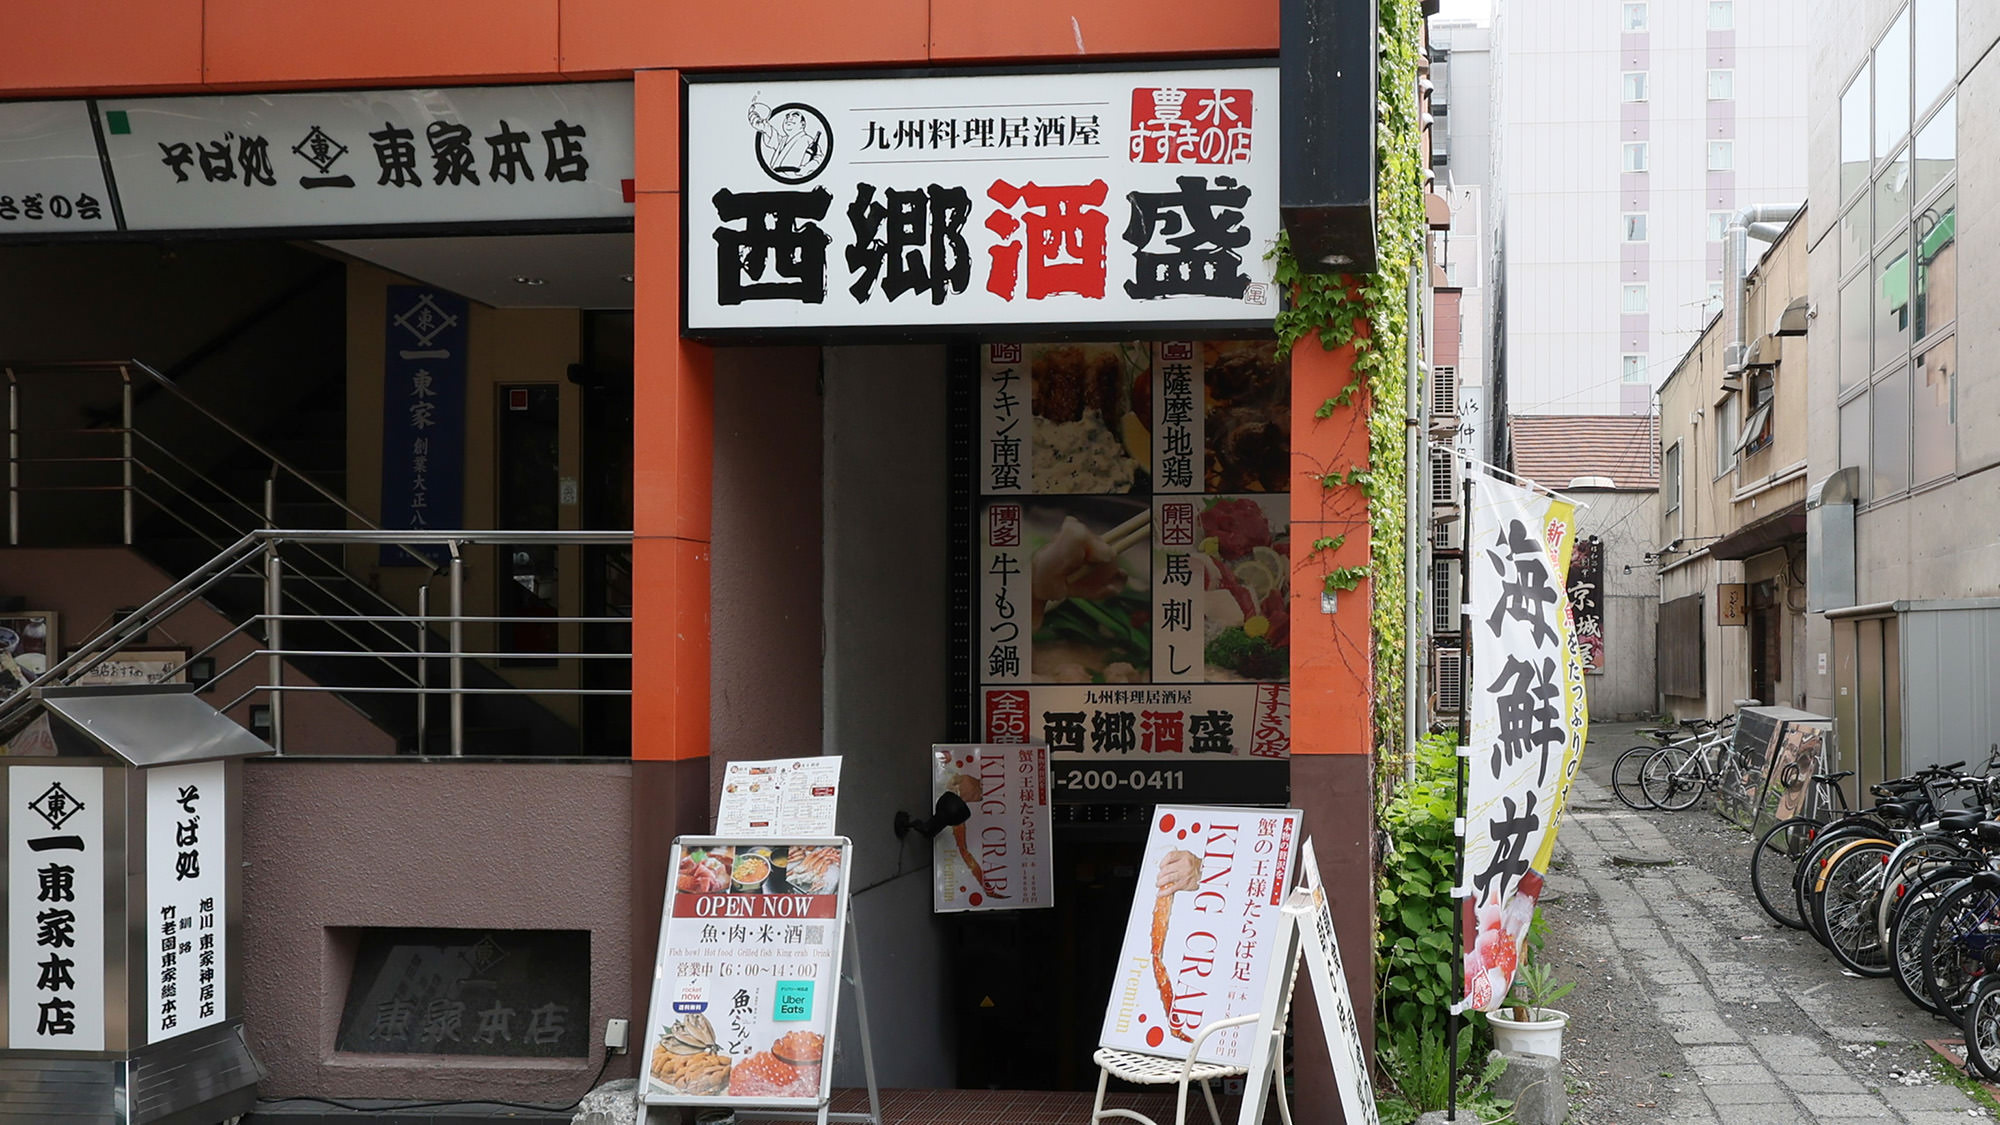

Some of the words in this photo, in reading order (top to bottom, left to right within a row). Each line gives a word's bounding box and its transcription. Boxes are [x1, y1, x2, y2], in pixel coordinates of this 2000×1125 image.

[859, 114, 1101, 152] 九州料理居酒屋
[1149, 87, 1239, 125] 豊水
[158, 132, 277, 187] そば処
[370, 119, 589, 188] 東家本店
[1129, 126, 1251, 166] すすきの店
[711, 174, 1252, 306] 西郷酒盛
[409, 368, 438, 430] 東家
[991, 369, 1022, 491] チキン南蛮
[1161, 364, 1193, 488] 薩摩地鶏
[409, 437, 429, 530] 創業大正八
[991, 506, 1019, 546] 博多
[1165, 505, 1192, 544] 熊本
[988, 553, 1021, 678] 牛もつ鍋
[1161, 553, 1193, 676] 馬刺し
[1043, 710, 1234, 753] 西郷酒盛
[1083, 690, 1192, 704] 九州料理居酒屋
[980, 756, 1007, 816] KING
[1018, 749, 1036, 856] 蟹の王様たらば足
[176, 785, 200, 882] そば処
[981, 826, 1009, 895] CRAB
[1194, 823, 1239, 915] KING
[1231, 817, 1278, 982] 蟹の王様たらば足
[697, 896, 757, 917] OPEN
[762, 896, 813, 917] NOW
[37, 862, 76, 1036] 東家本店
[161, 905, 177, 1031] 竹老園東家総本店
[1168, 931, 1218, 1031] CRAB
[369, 1000, 569, 1045] 東家本店
[681, 993, 702, 1001] now
[781, 1005, 804, 1014] Eats
[782, 995, 805, 1004] Uber
[1115, 956, 1150, 1034] Premium
